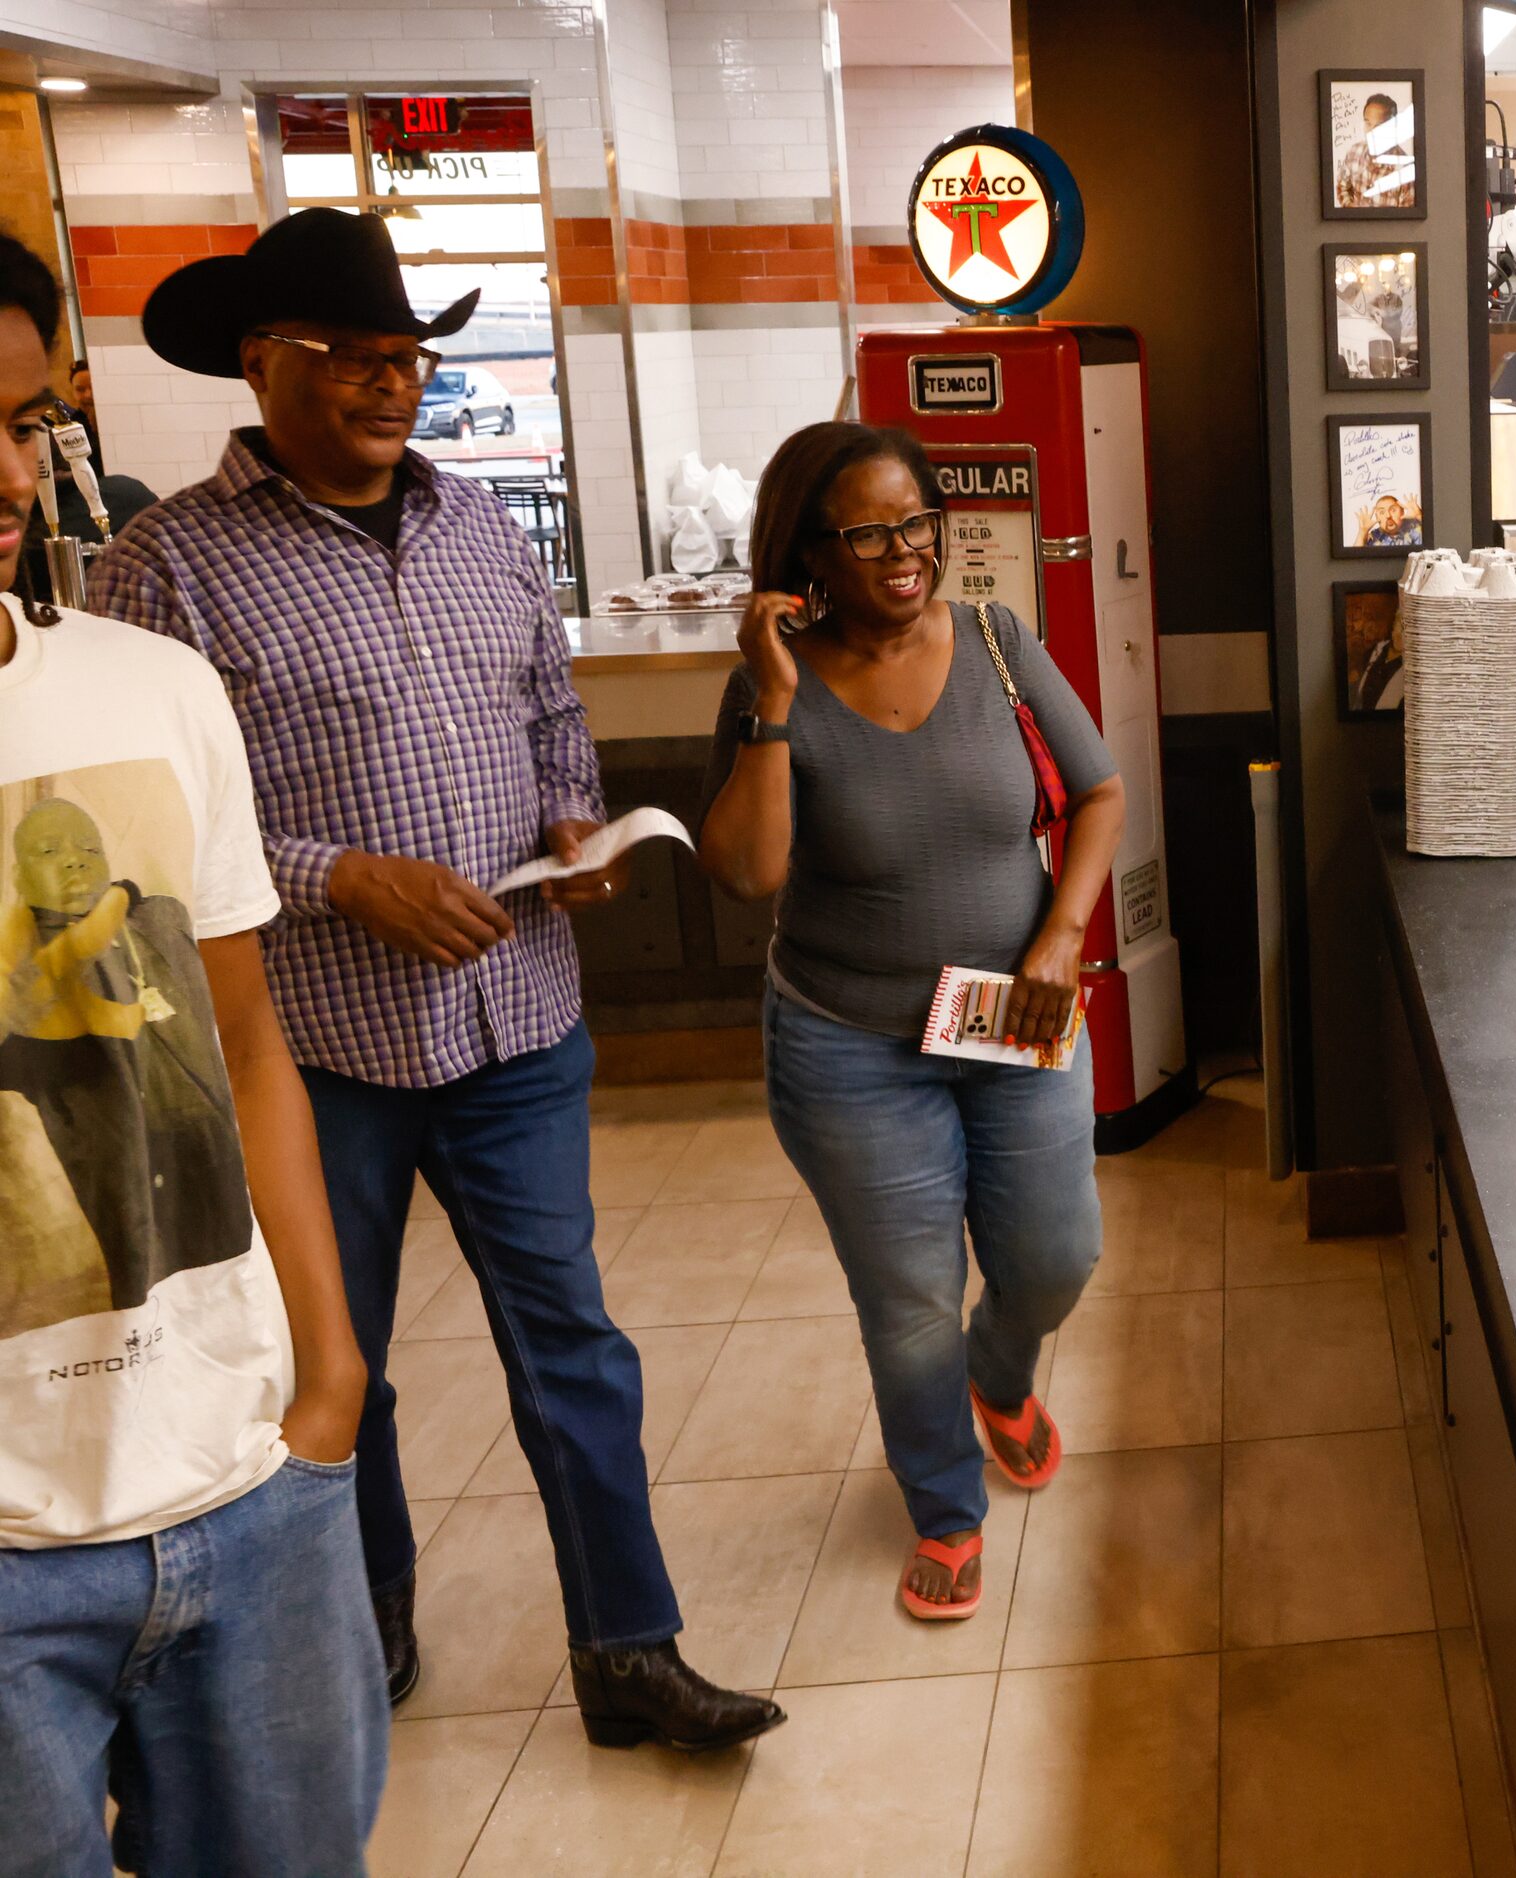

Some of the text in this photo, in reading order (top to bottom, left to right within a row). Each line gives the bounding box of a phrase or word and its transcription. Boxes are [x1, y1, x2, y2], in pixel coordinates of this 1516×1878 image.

[402, 97, 448, 132] EXIT
[931, 176, 1026, 197] TEXACO
[952, 203, 998, 255] T
[927, 377, 987, 393] TEXACO
[937, 467, 1030, 495] GULAR
[1132, 904, 1153, 925] LEAD
[940, 980, 969, 1043] Portillo's
